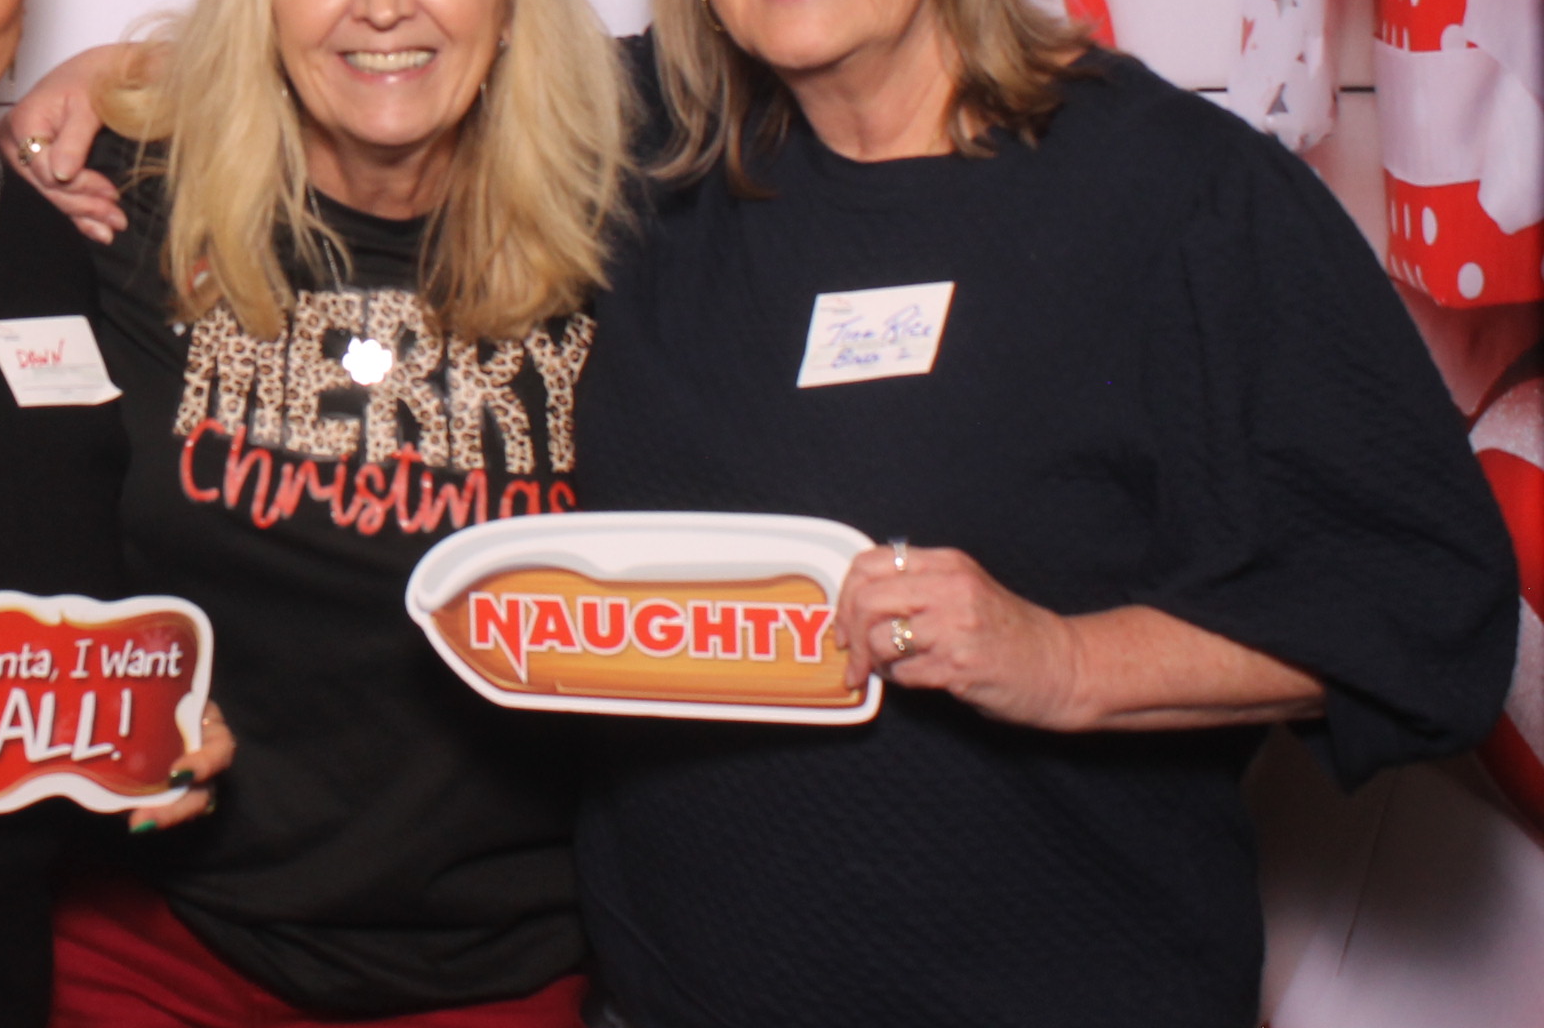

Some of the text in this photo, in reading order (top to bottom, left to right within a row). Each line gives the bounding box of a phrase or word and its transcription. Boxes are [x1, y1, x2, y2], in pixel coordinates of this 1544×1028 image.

[172, 289, 597, 474] MERRY
[69, 638, 94, 680] I
[100, 638, 183, 679] Want
[469, 591, 836, 683] NAUGHTY
